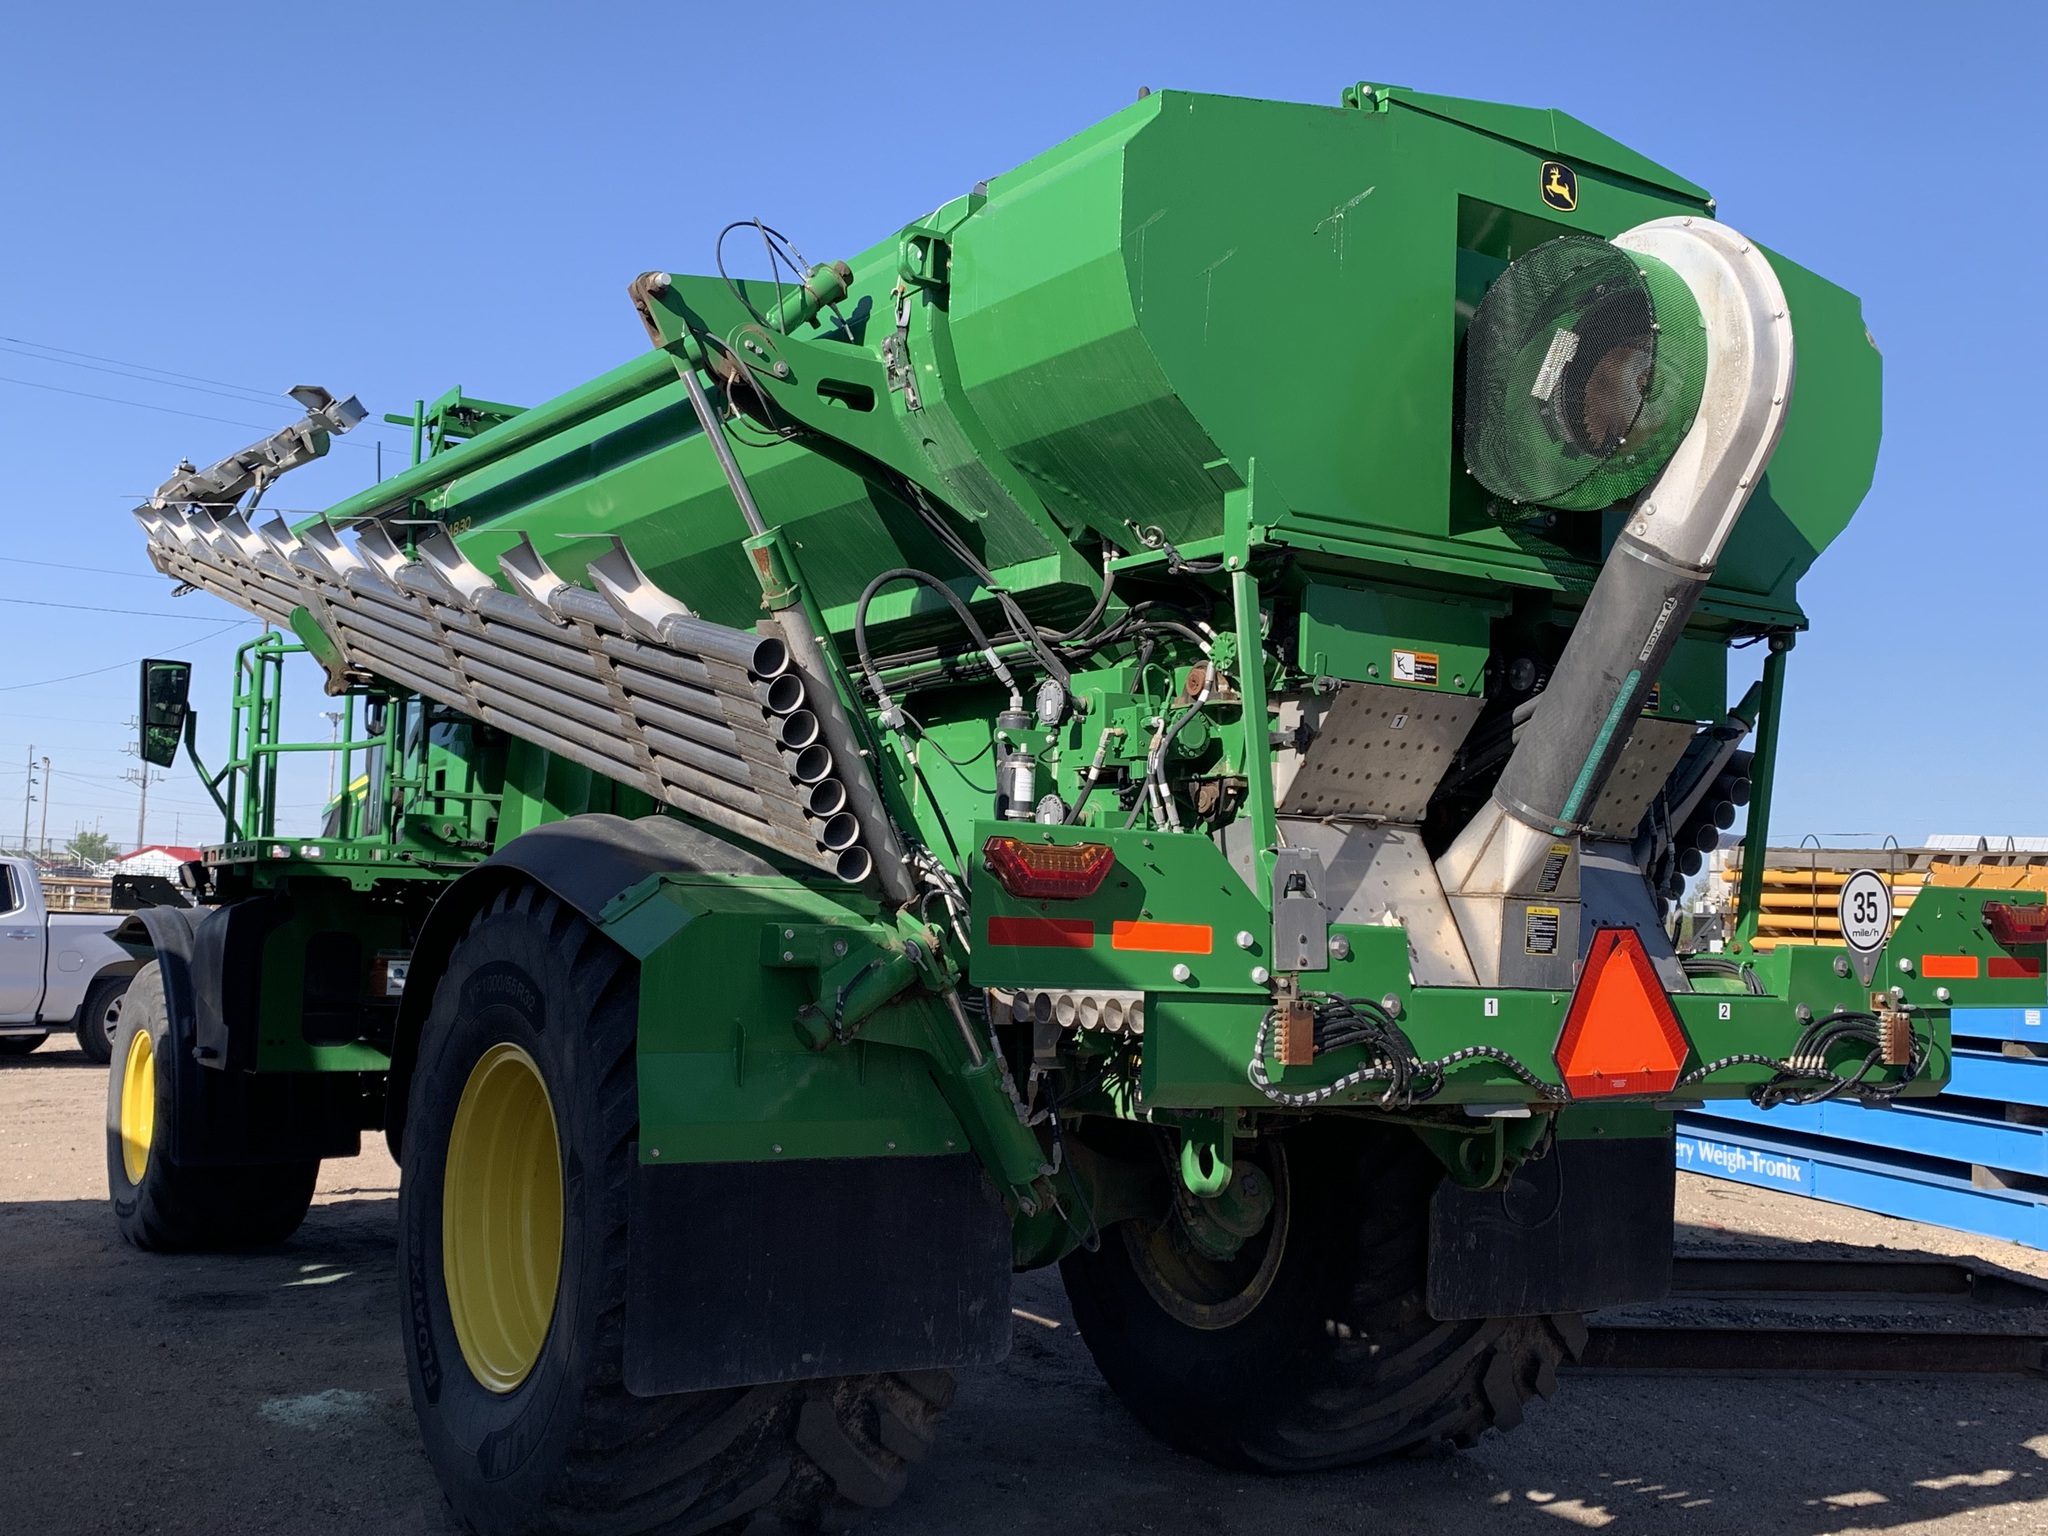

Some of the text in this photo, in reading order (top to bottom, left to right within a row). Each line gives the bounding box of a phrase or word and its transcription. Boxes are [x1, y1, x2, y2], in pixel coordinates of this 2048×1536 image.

[1642, 612, 1669, 657] TEXCEL
[1395, 715, 1404, 728] 1
[1853, 891, 1878, 924] 35
[1852, 928, 1880, 937] mile/h
[1488, 1000, 1495, 1015] 1
[1720, 1005, 1728, 1018] 2
[1697, 1140, 1801, 1182] Weigh-Tronix
